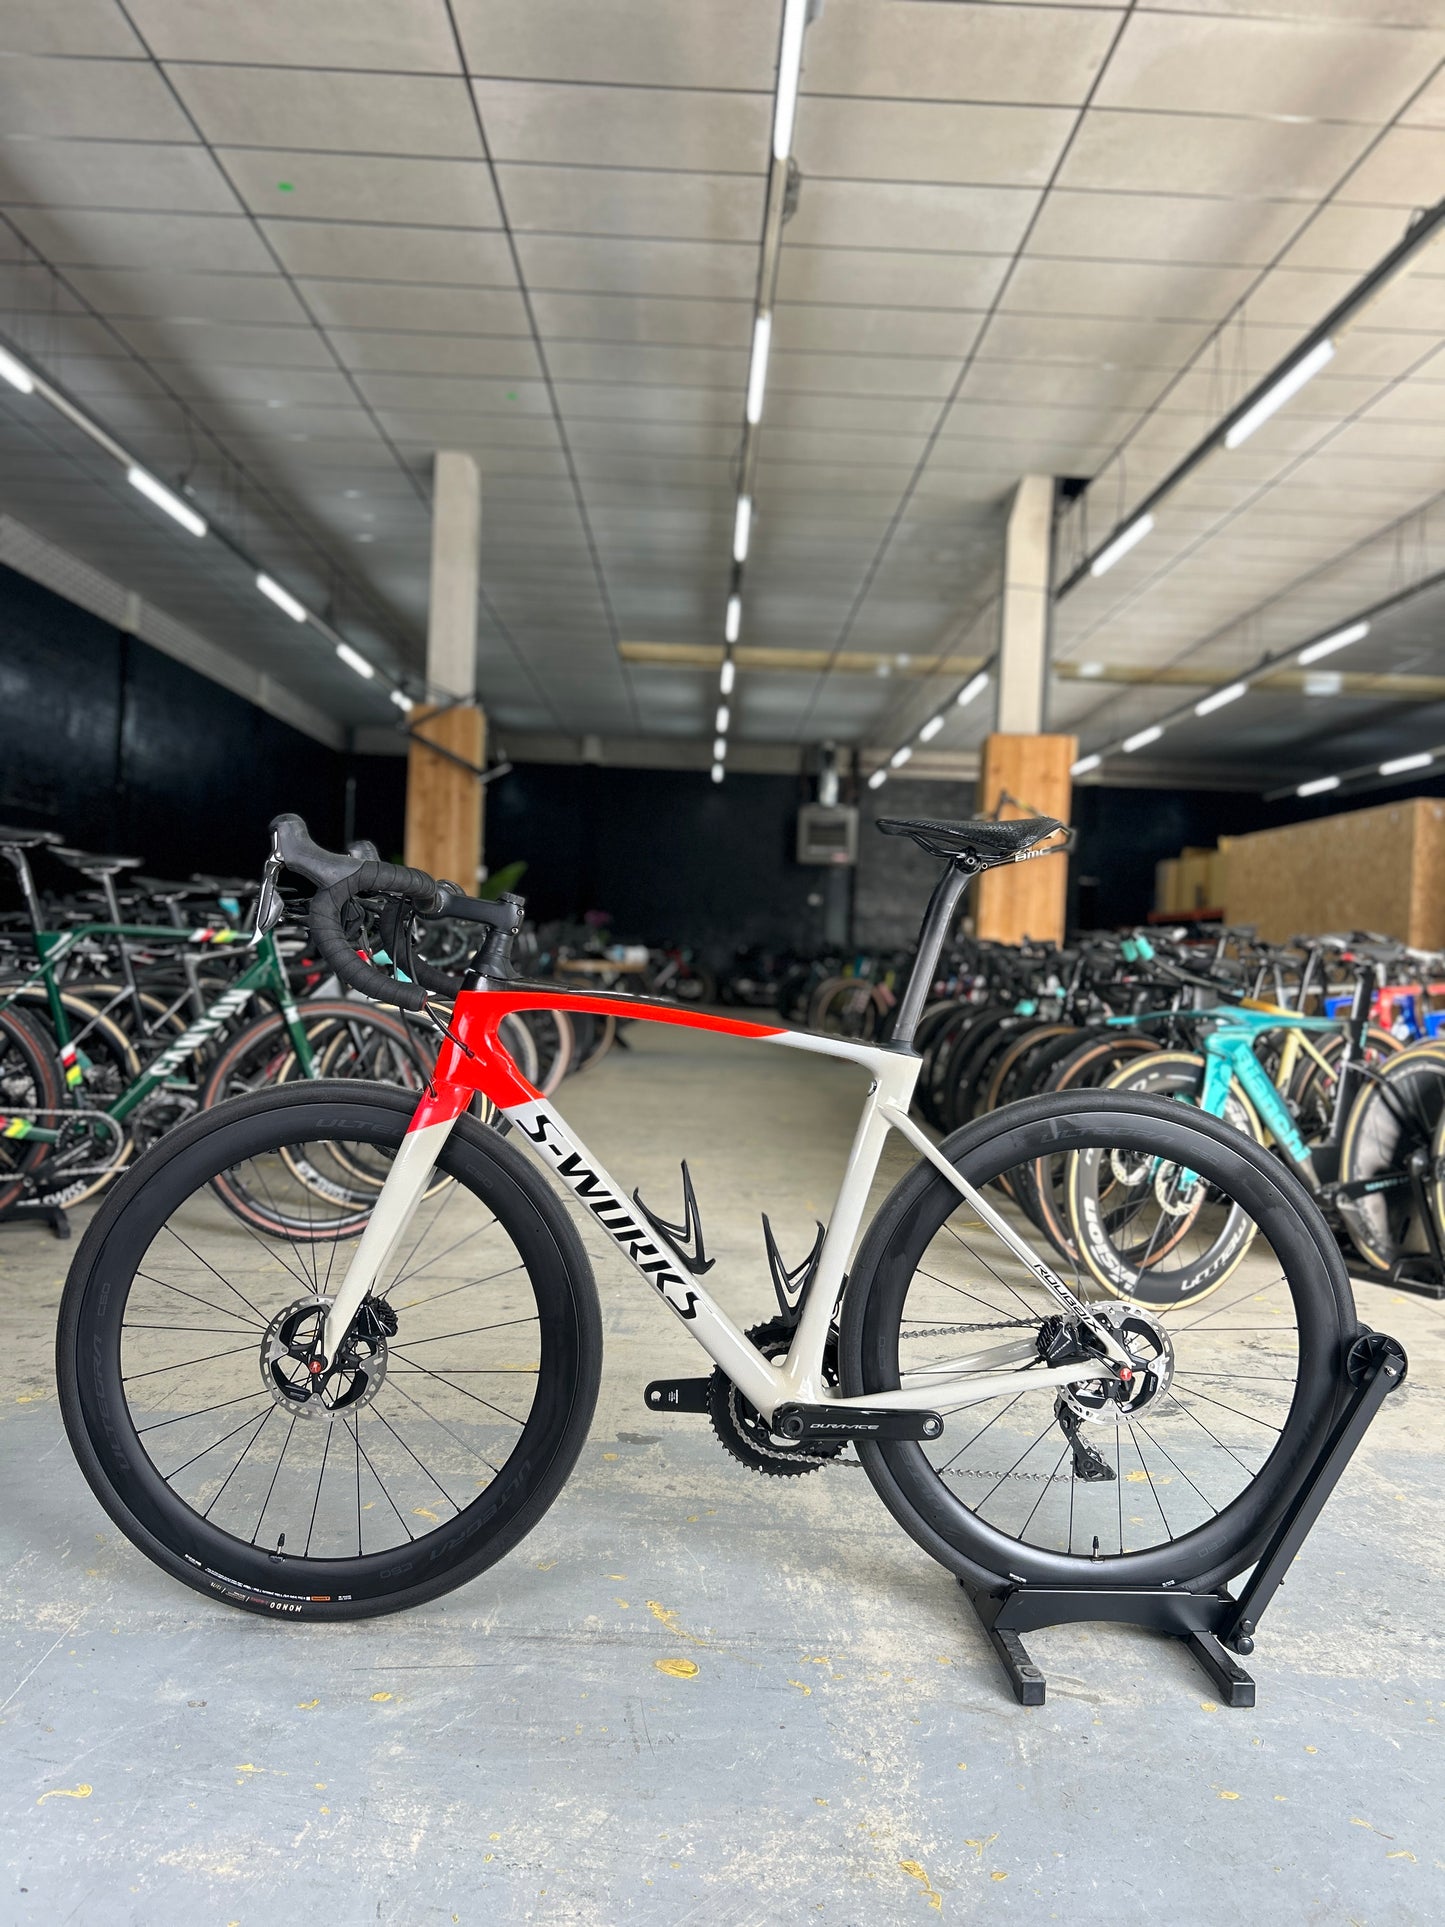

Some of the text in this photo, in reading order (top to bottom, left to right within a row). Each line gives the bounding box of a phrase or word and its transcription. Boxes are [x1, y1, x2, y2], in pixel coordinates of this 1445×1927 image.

[149, 988, 254, 1076] CANYON
[1238, 1050, 1313, 1163] Bianchi
[515, 1113, 702, 1320] S-WORKS
[269, 1600, 302, 1613] MONDO
